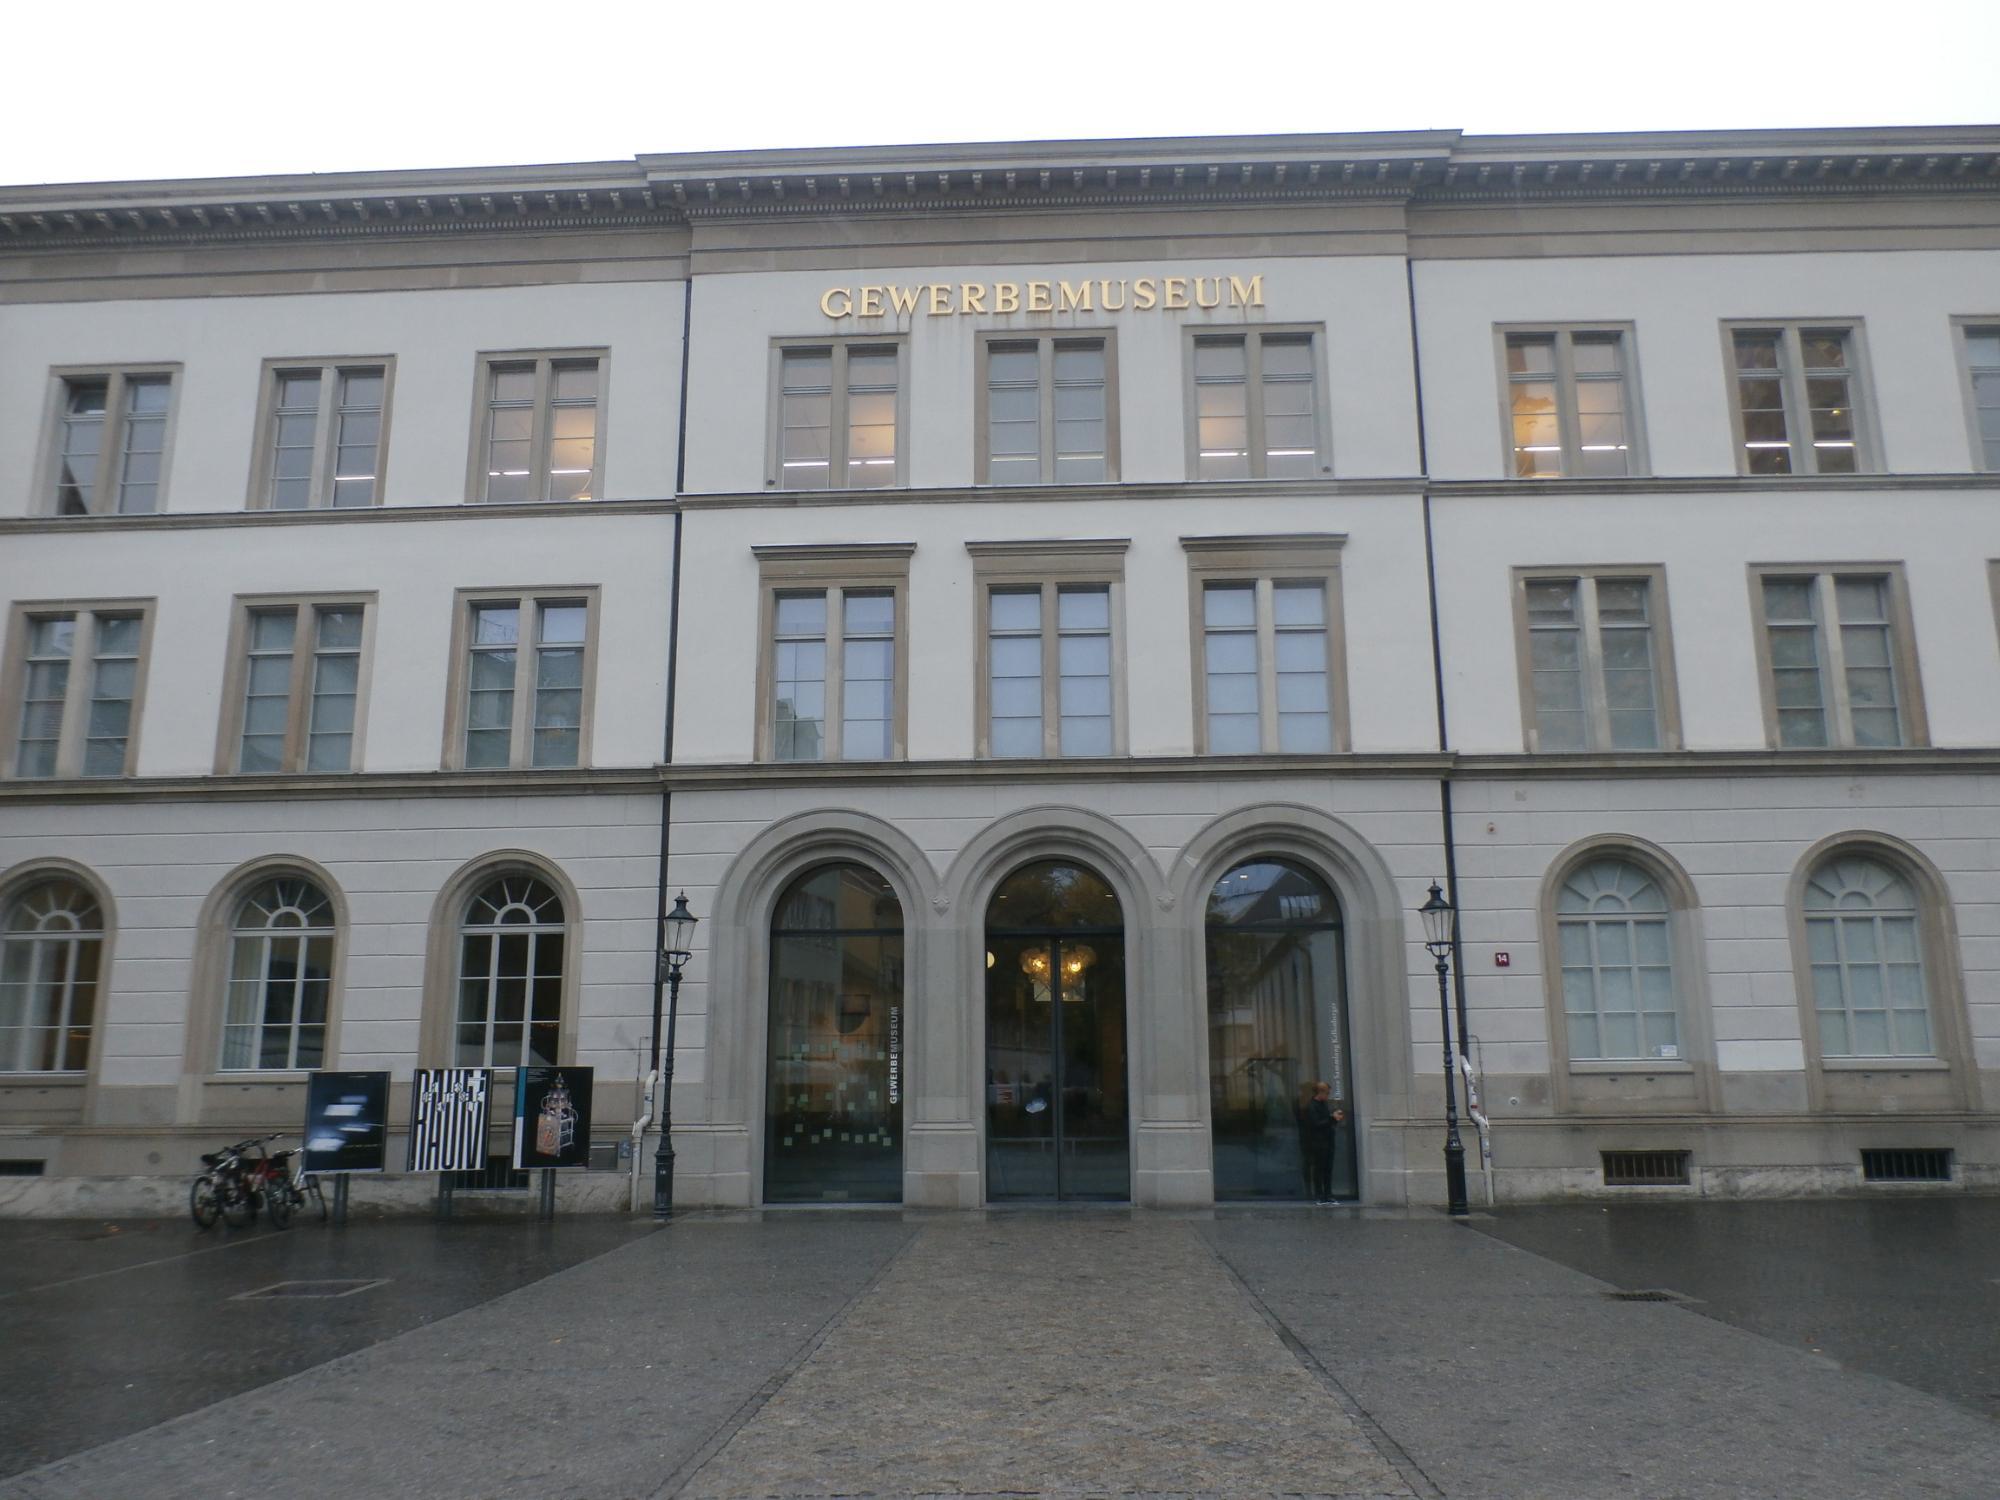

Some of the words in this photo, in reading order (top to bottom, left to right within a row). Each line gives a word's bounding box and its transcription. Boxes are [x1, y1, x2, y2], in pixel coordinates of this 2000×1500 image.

[820, 275, 1266, 319] GEWERBEMUSEUM
[1497, 954, 1507, 963] 14
[889, 1006, 899, 1105] GEWERBEMUSEUM
